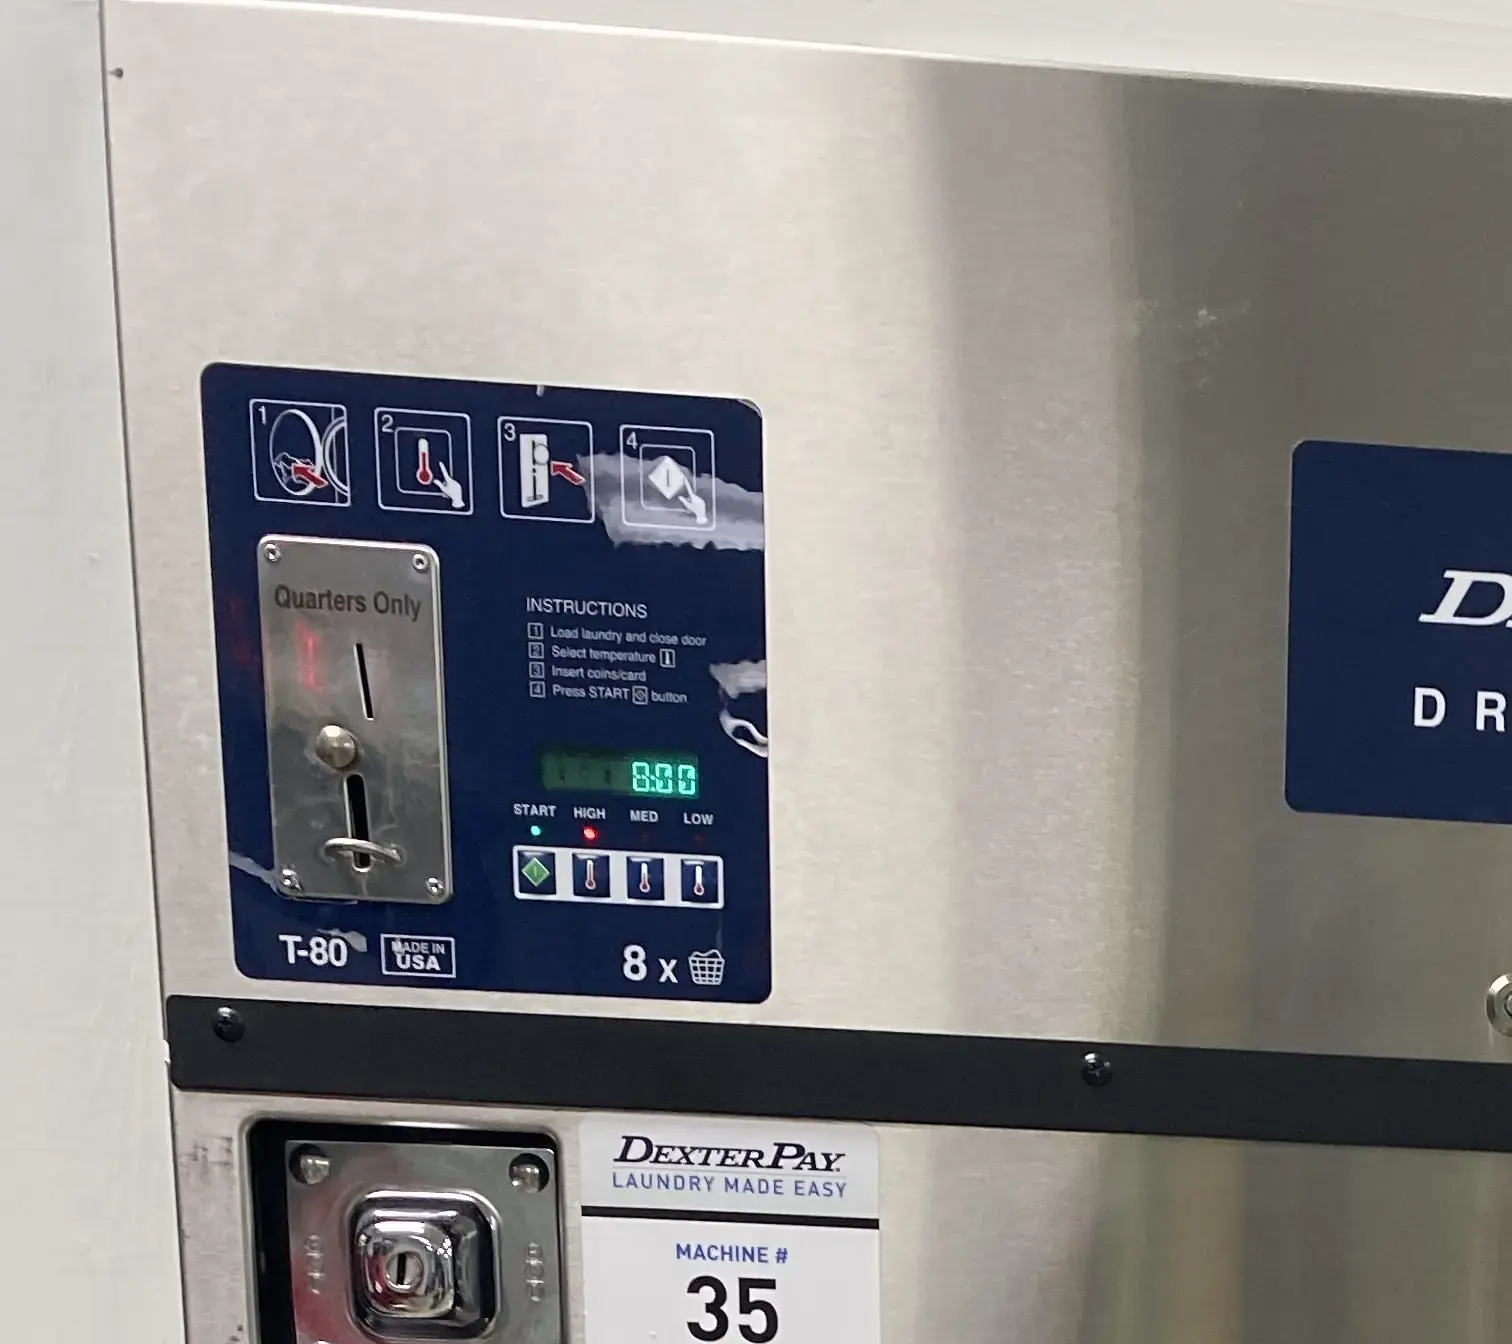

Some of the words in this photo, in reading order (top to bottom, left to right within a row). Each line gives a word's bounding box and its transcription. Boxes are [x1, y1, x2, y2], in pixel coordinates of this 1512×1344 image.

[257, 406, 267, 424] 1
[381, 415, 393, 432] 2
[505, 424, 516, 442] 3
[626, 432, 638, 449] 4
[274, 584, 367, 612] Quarters
[373, 591, 421, 622] Only
[526, 597, 648, 618] INSTRUCTIONS
[550, 625, 578, 639] Load
[581, 627, 622, 644] laundry
[626, 631, 647, 643] and
[649, 632, 678, 644] close
[681, 634, 707, 646] door
[552, 646, 586, 659] Select
[589, 648, 656, 663] temperature
[552, 665, 584, 678] Insert
[587, 667, 647, 681] coins/card
[552, 684, 586, 698] Press
[589, 686, 629, 700] START
[651, 690, 687, 703] button
[632, 761, 696, 795] 8:00
[513, 803, 556, 817] START
[573, 807, 606, 820] HIGH
[630, 809, 659, 823] MED
[683, 812, 714, 825] LOW
[278, 934, 348, 967] T-80
[391, 940, 429, 954] MADE
[432, 943, 445, 955] IN
[395, 954, 441, 971] USA
[623, 944, 647, 981] 8
[612, 1171, 716, 1192] LAUNDRY
[724, 1177, 784, 1195] MADE
[794, 1180, 847, 1199] EASY
[676, 1243, 769, 1263] MACHINE
[775, 1247, 788, 1264] #
[686, 1275, 779, 1344] 35
